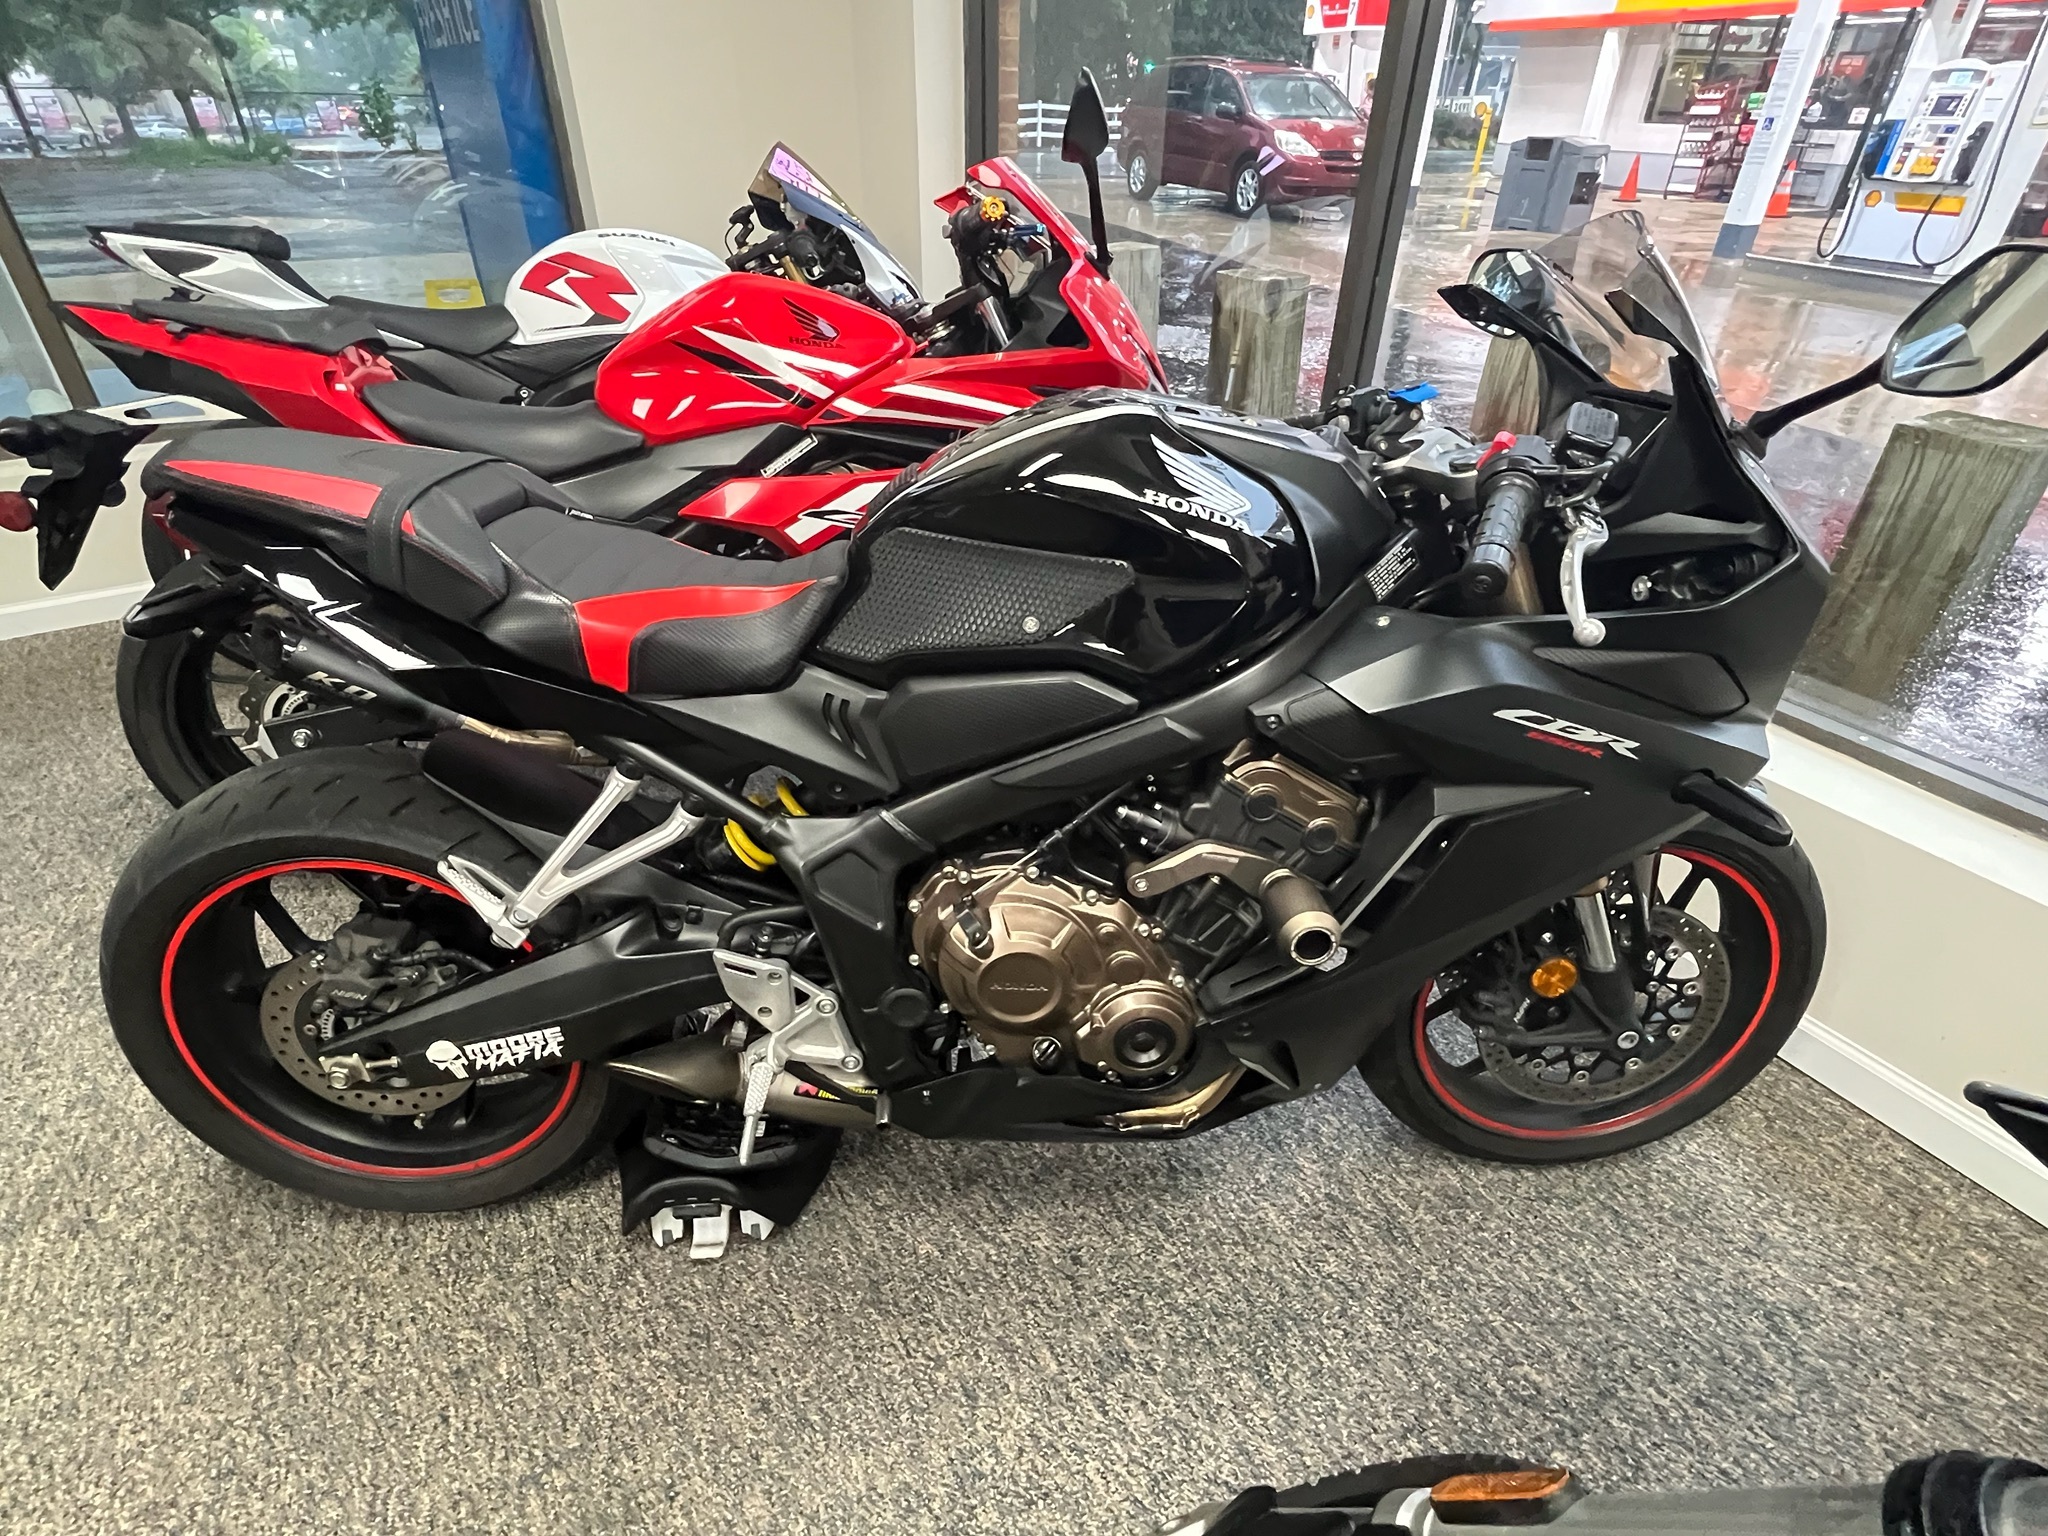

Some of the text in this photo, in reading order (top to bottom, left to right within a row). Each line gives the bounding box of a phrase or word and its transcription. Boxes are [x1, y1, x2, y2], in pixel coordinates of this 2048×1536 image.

[598, 232, 676, 247] SUZUKI
[788, 336, 846, 349] HONDA
[1142, 488, 1256, 536] HONDA
[1493, 709, 1641, 760] CBR
[990, 982, 1048, 991] HONDA
[463, 1026, 564, 1060] MOORE
[474, 1039, 563, 1072] MAFIA
